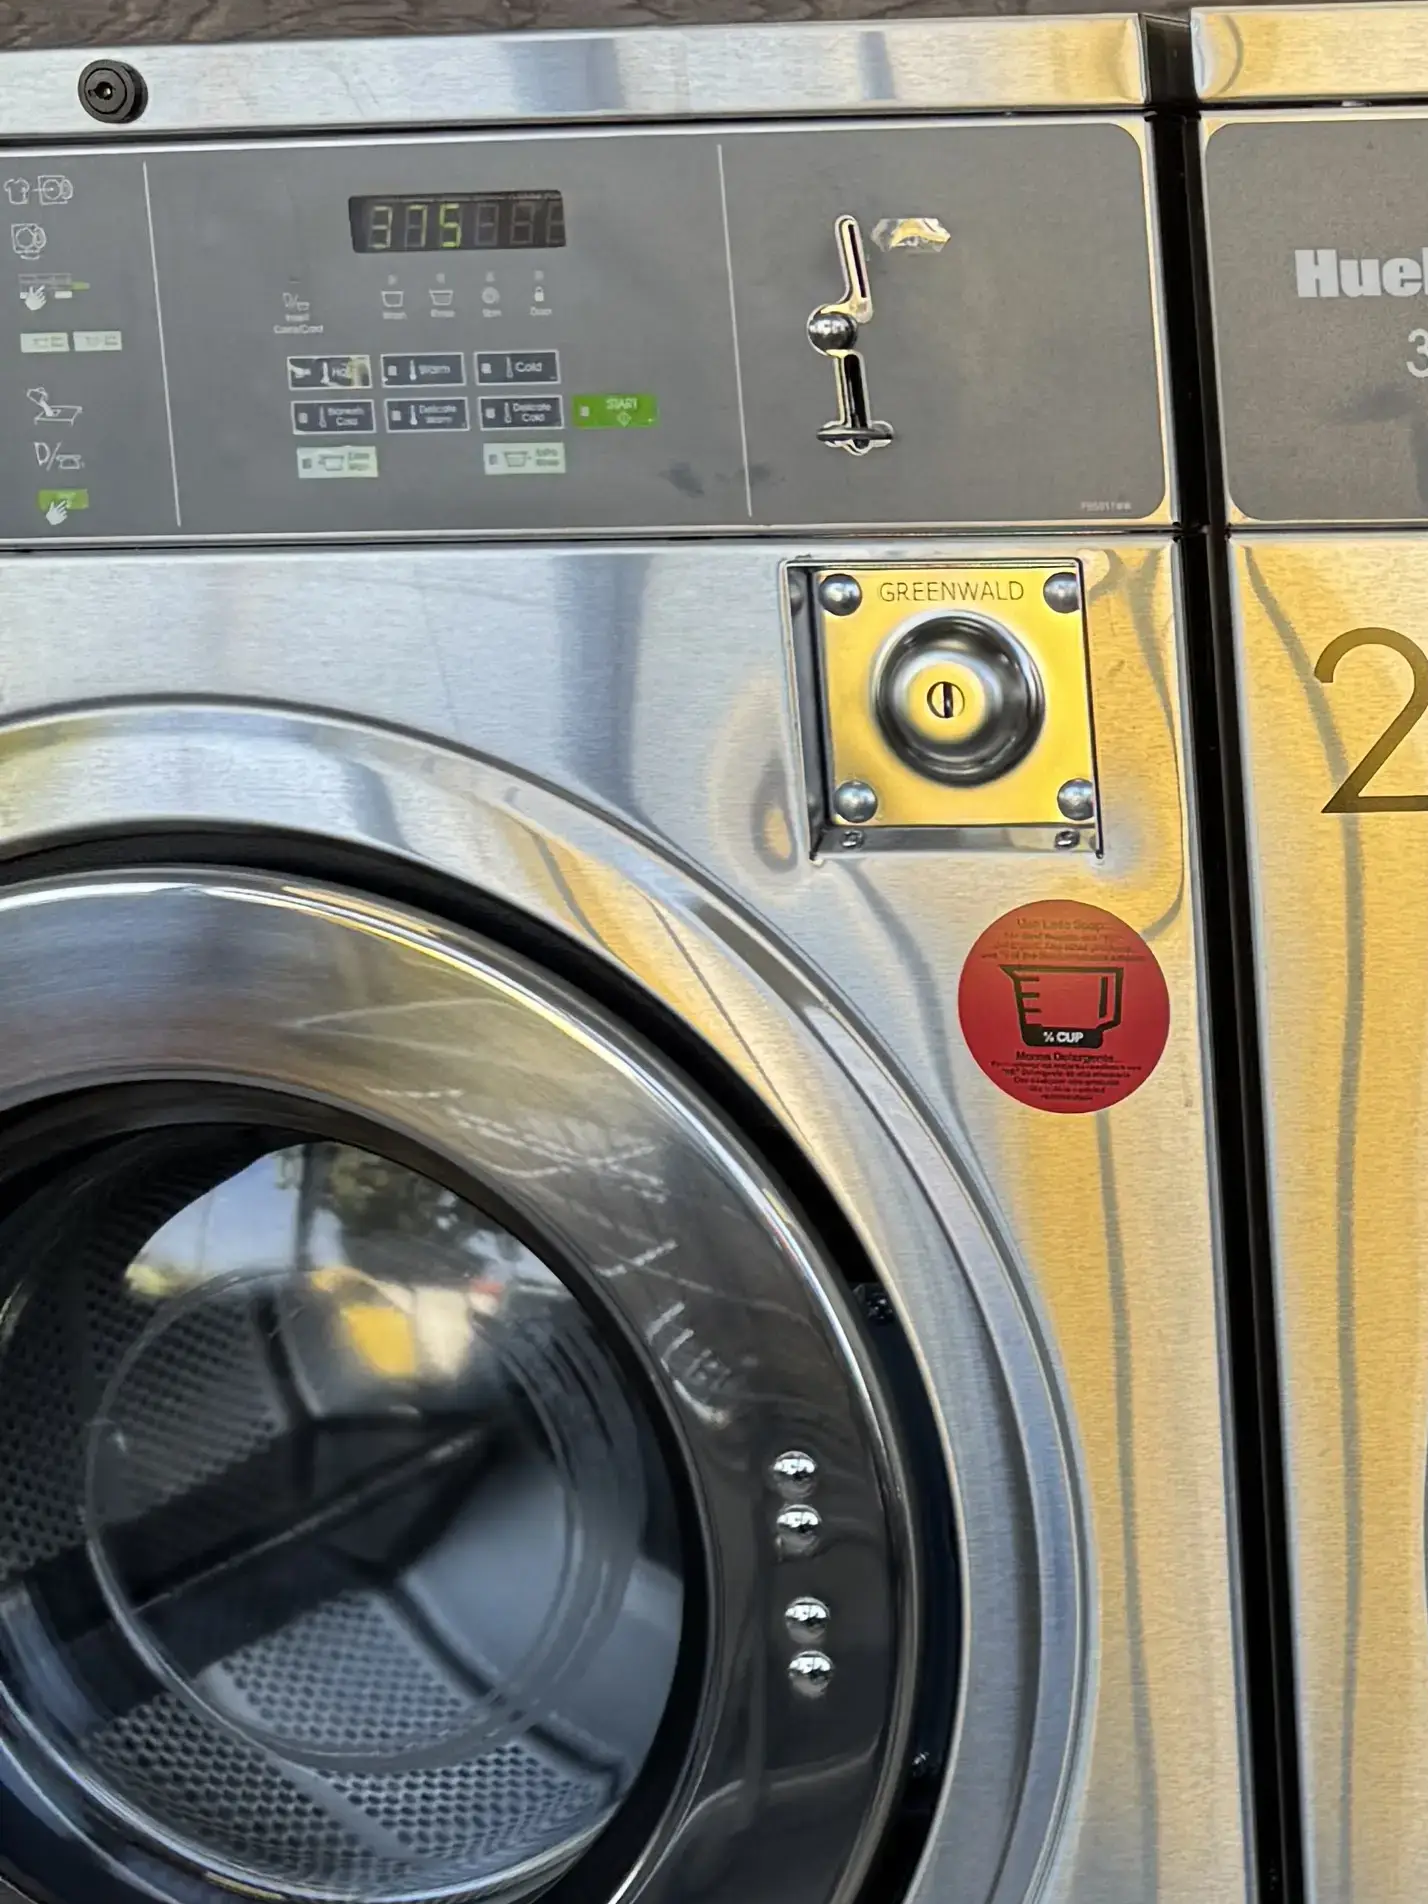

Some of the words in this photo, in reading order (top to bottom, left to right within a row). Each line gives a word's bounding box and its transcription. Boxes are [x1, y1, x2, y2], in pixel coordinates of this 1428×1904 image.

[514, 361, 543, 373] Cold
[605, 397, 638, 410] START
[878, 580, 1026, 604] GREENWALD
[1056, 1031, 1084, 1043] CUP
